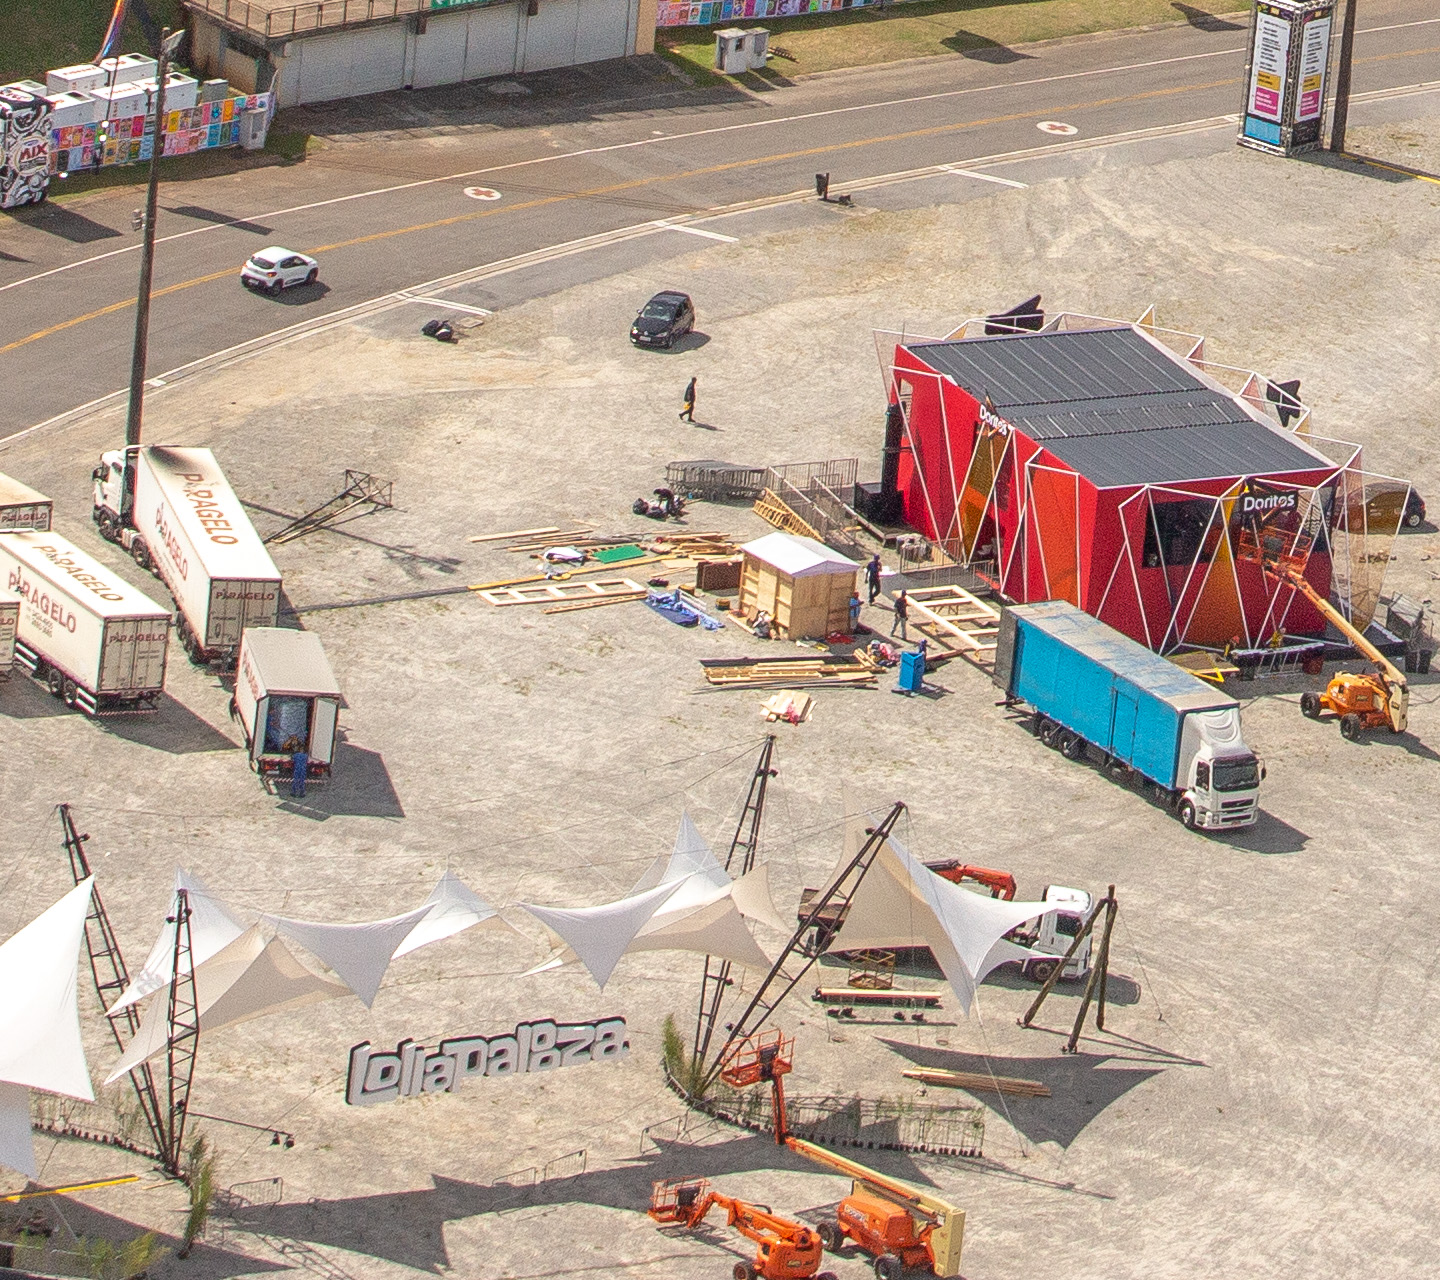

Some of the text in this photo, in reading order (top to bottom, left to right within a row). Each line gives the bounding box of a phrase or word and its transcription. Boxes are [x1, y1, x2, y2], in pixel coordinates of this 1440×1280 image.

[21, 144, 47, 160] MIX
[980, 405, 1008, 436] Doritos
[1244, 492, 1295, 511] Doritos
